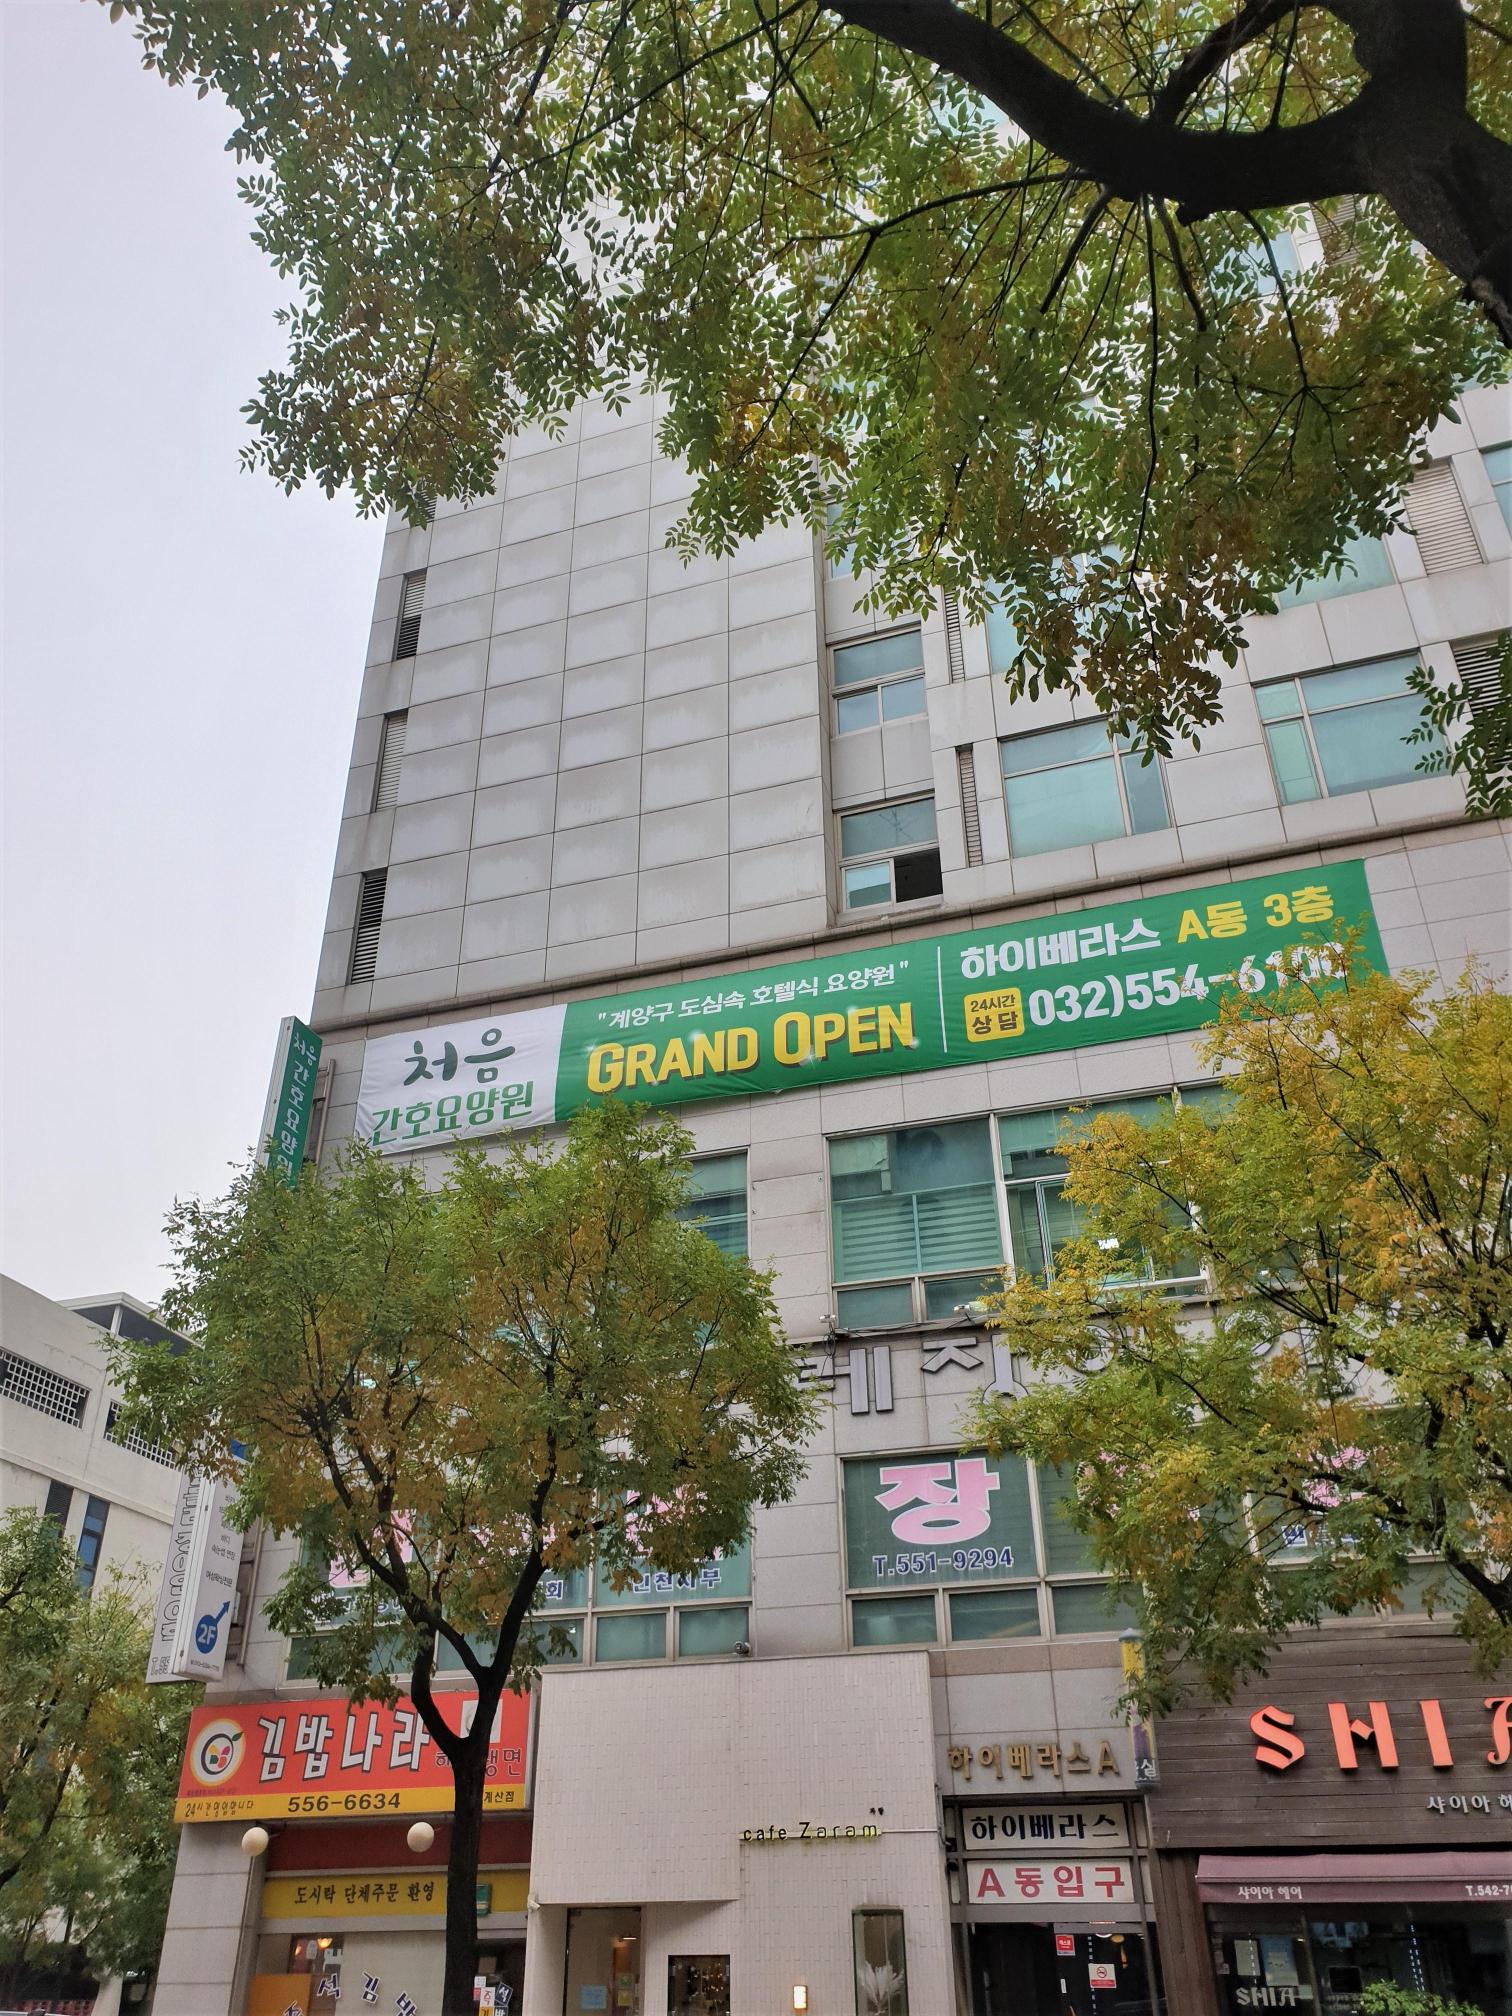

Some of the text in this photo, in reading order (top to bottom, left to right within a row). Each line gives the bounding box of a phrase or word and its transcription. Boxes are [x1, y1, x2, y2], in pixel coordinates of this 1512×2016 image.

[960, 885, 1334, 979] 하이베라스 A동 3층
[678, 991, 746, 1018] 도심속
[750, 976, 818, 1006] 호텔식
[970, 994, 1016, 1013] 24시간
[403, 1028, 516, 1086] 처음
[587, 1002, 914, 1094] GRAND OPEN
[372, 1081, 534, 1146] 간호요양원
[874, 1457, 1001, 1545] 장
[872, 1546, 1014, 1577] T.551-9294
[199, 1624, 216, 1647] 2F
[258, 1710, 432, 1783] 김밥나라
[287, 1793, 401, 1813] 556-6634
[1427, 1795, 1491, 1815] 샤이아
[743, 1822, 878, 1841] cafe Zaram
[970, 1814, 1120, 1840] 하이베라스
[294, 1881, 434, 1904] 도시락 단체주문 환영
[1238, 1886, 1274, 1900] 샤이아
[1465, 1885, 1512, 1896] T.542-7
[1235, 1986, 1298, 2007] SHIA
